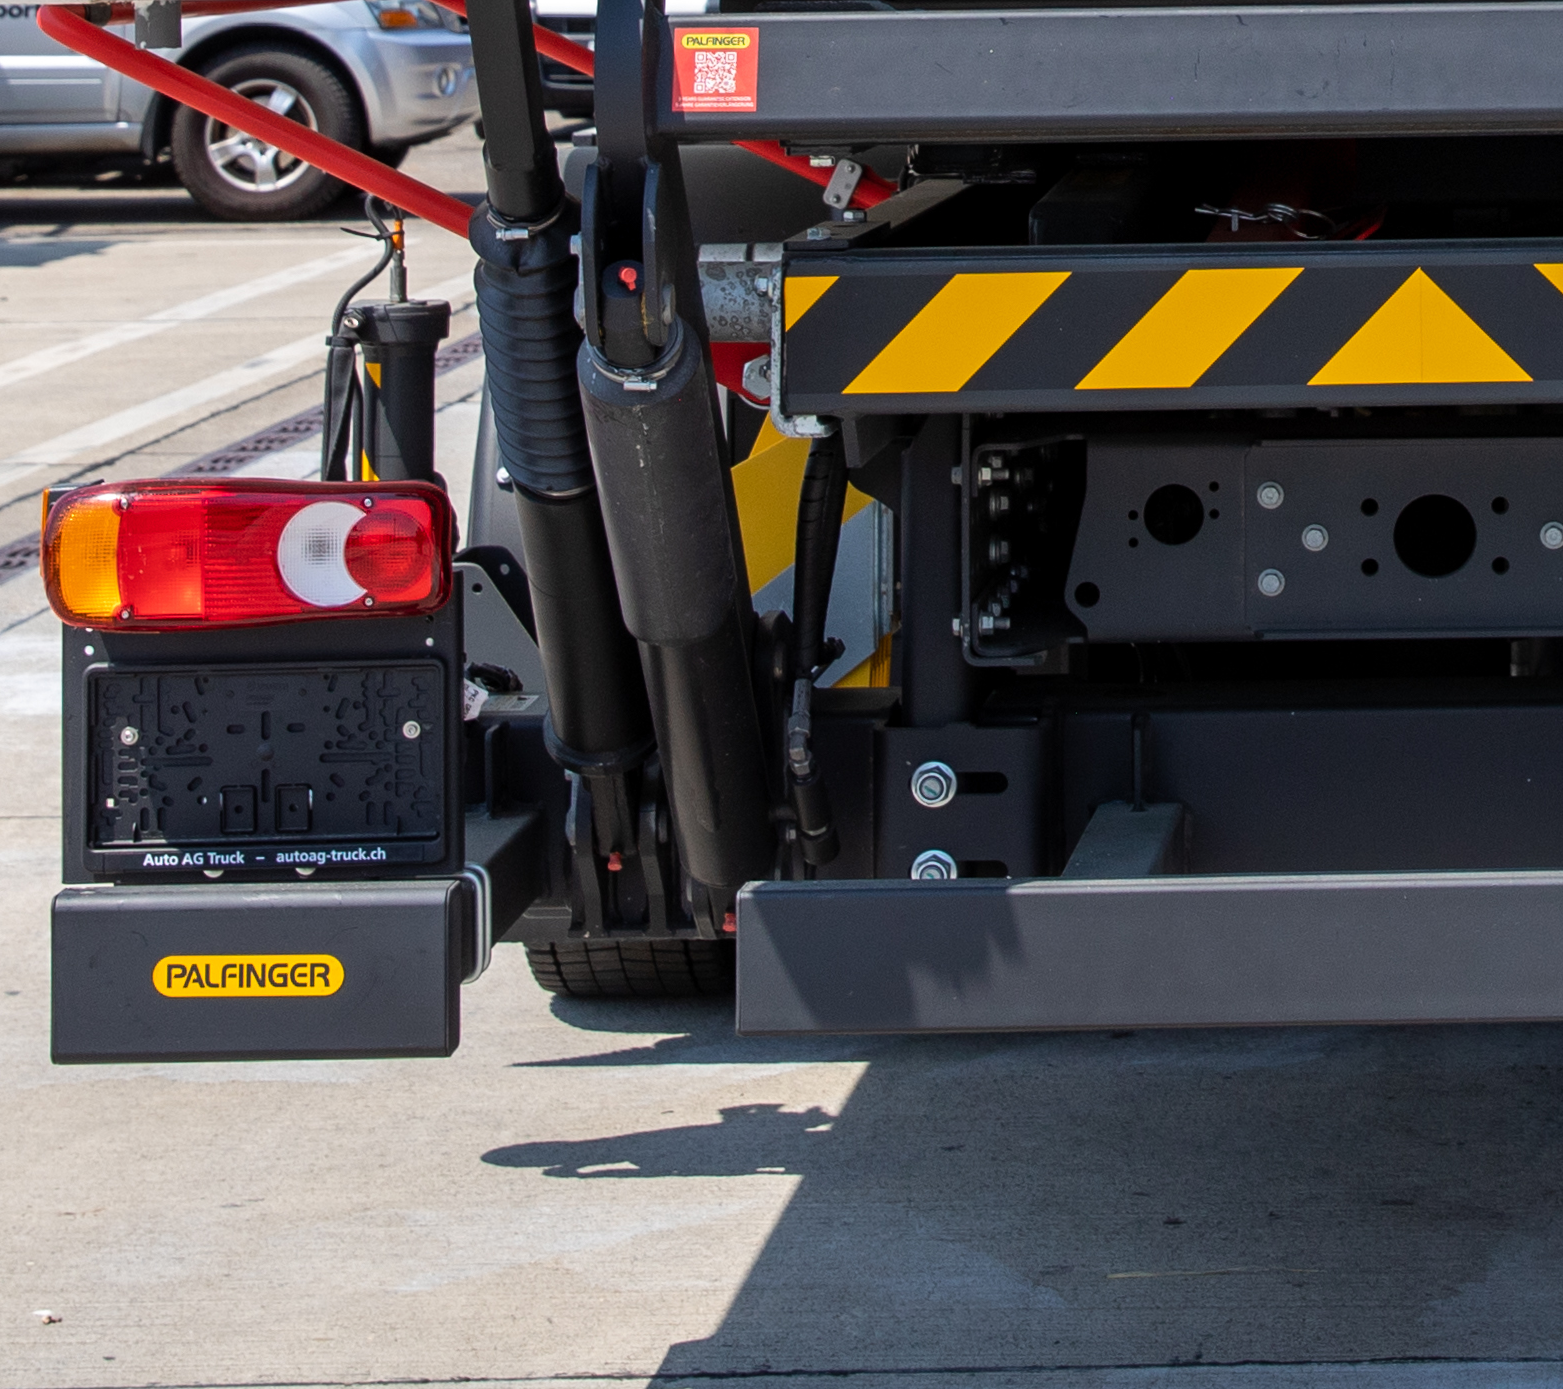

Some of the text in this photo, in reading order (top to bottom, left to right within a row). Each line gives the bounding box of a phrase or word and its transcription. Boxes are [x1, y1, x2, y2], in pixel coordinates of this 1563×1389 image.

[686, 36, 746, 46] PALFINGER
[143, 852, 179, 867] Auto
[181, 852, 203, 866] AG
[207, 851, 245, 865] Truck
[276, 846, 387, 864] autoag-truck.ch
[166, 962, 331, 989] PALFINGER
